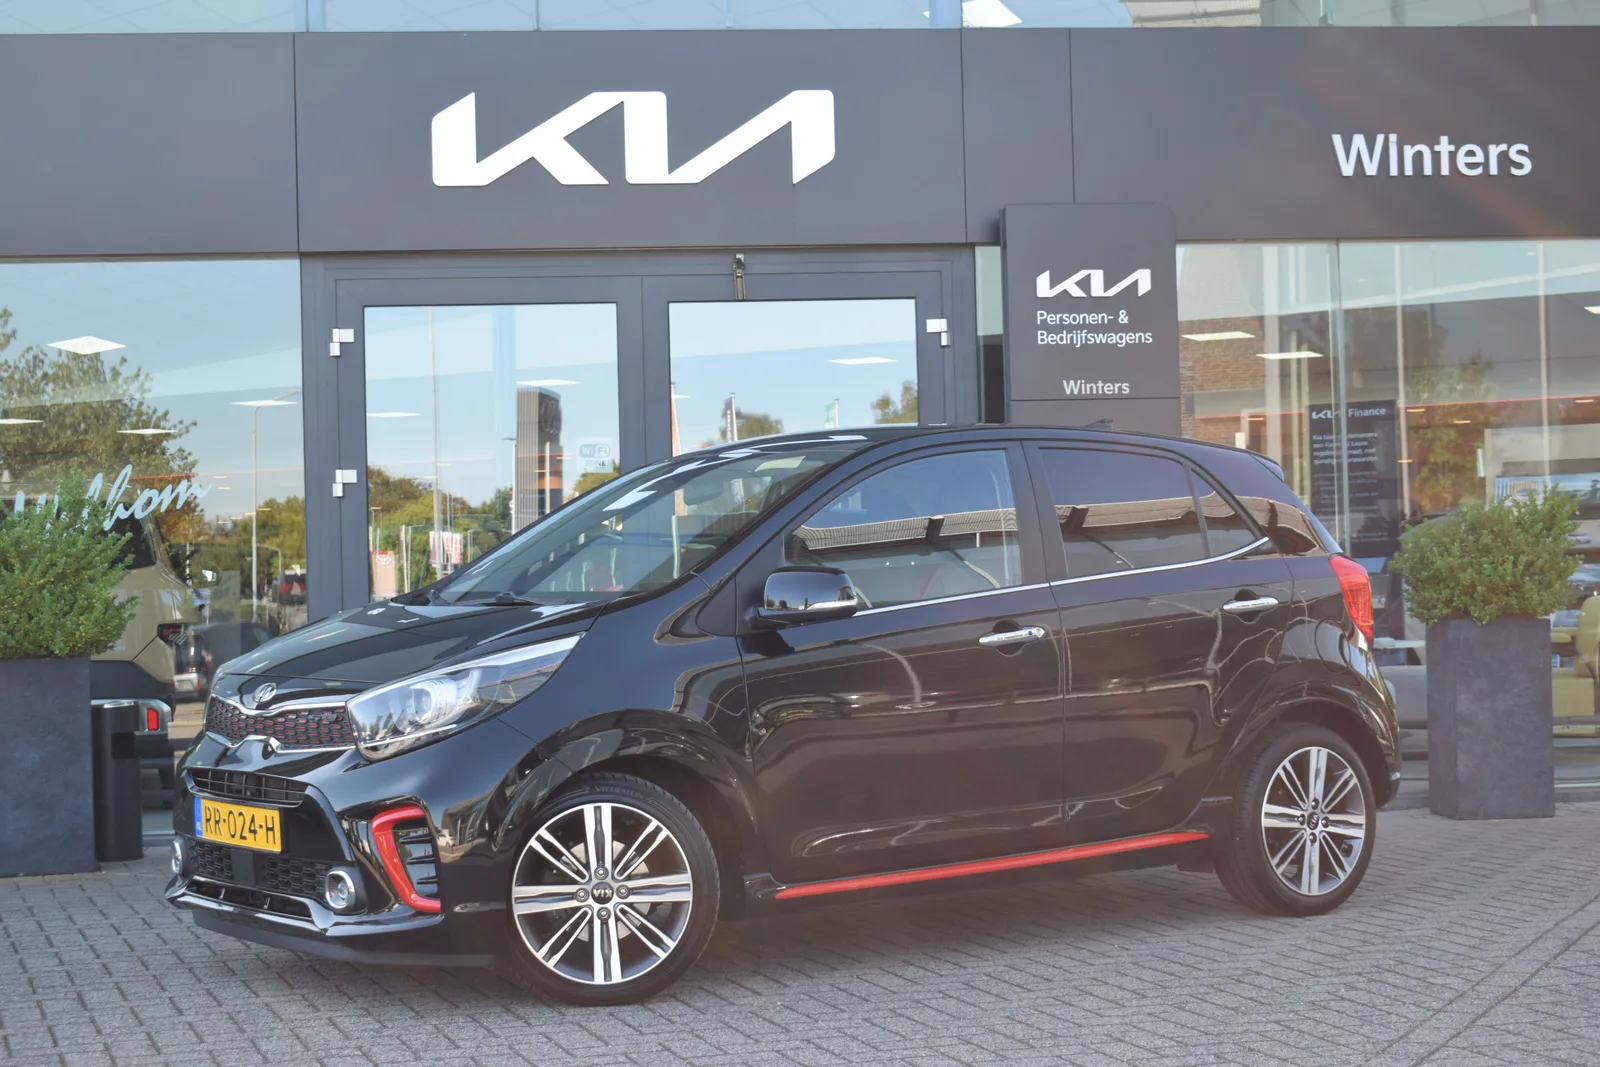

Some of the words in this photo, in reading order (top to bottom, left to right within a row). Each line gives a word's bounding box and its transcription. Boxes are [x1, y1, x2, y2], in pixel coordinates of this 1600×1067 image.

[432, 90, 835, 187] KIA
[1331, 133, 1532, 177] Winters
[1036, 268, 1151, 298] KIA
[1036, 310, 1114, 325] Personen-
[1118, 309, 1129, 324] &
[1037, 330, 1153, 348] Bedrijfswagens
[1062, 379, 1131, 395] Winters
[1348, 407, 1387, 418] Finance
[204, 805, 276, 845] RR-024-H
[593, 888, 613, 898] KIA
